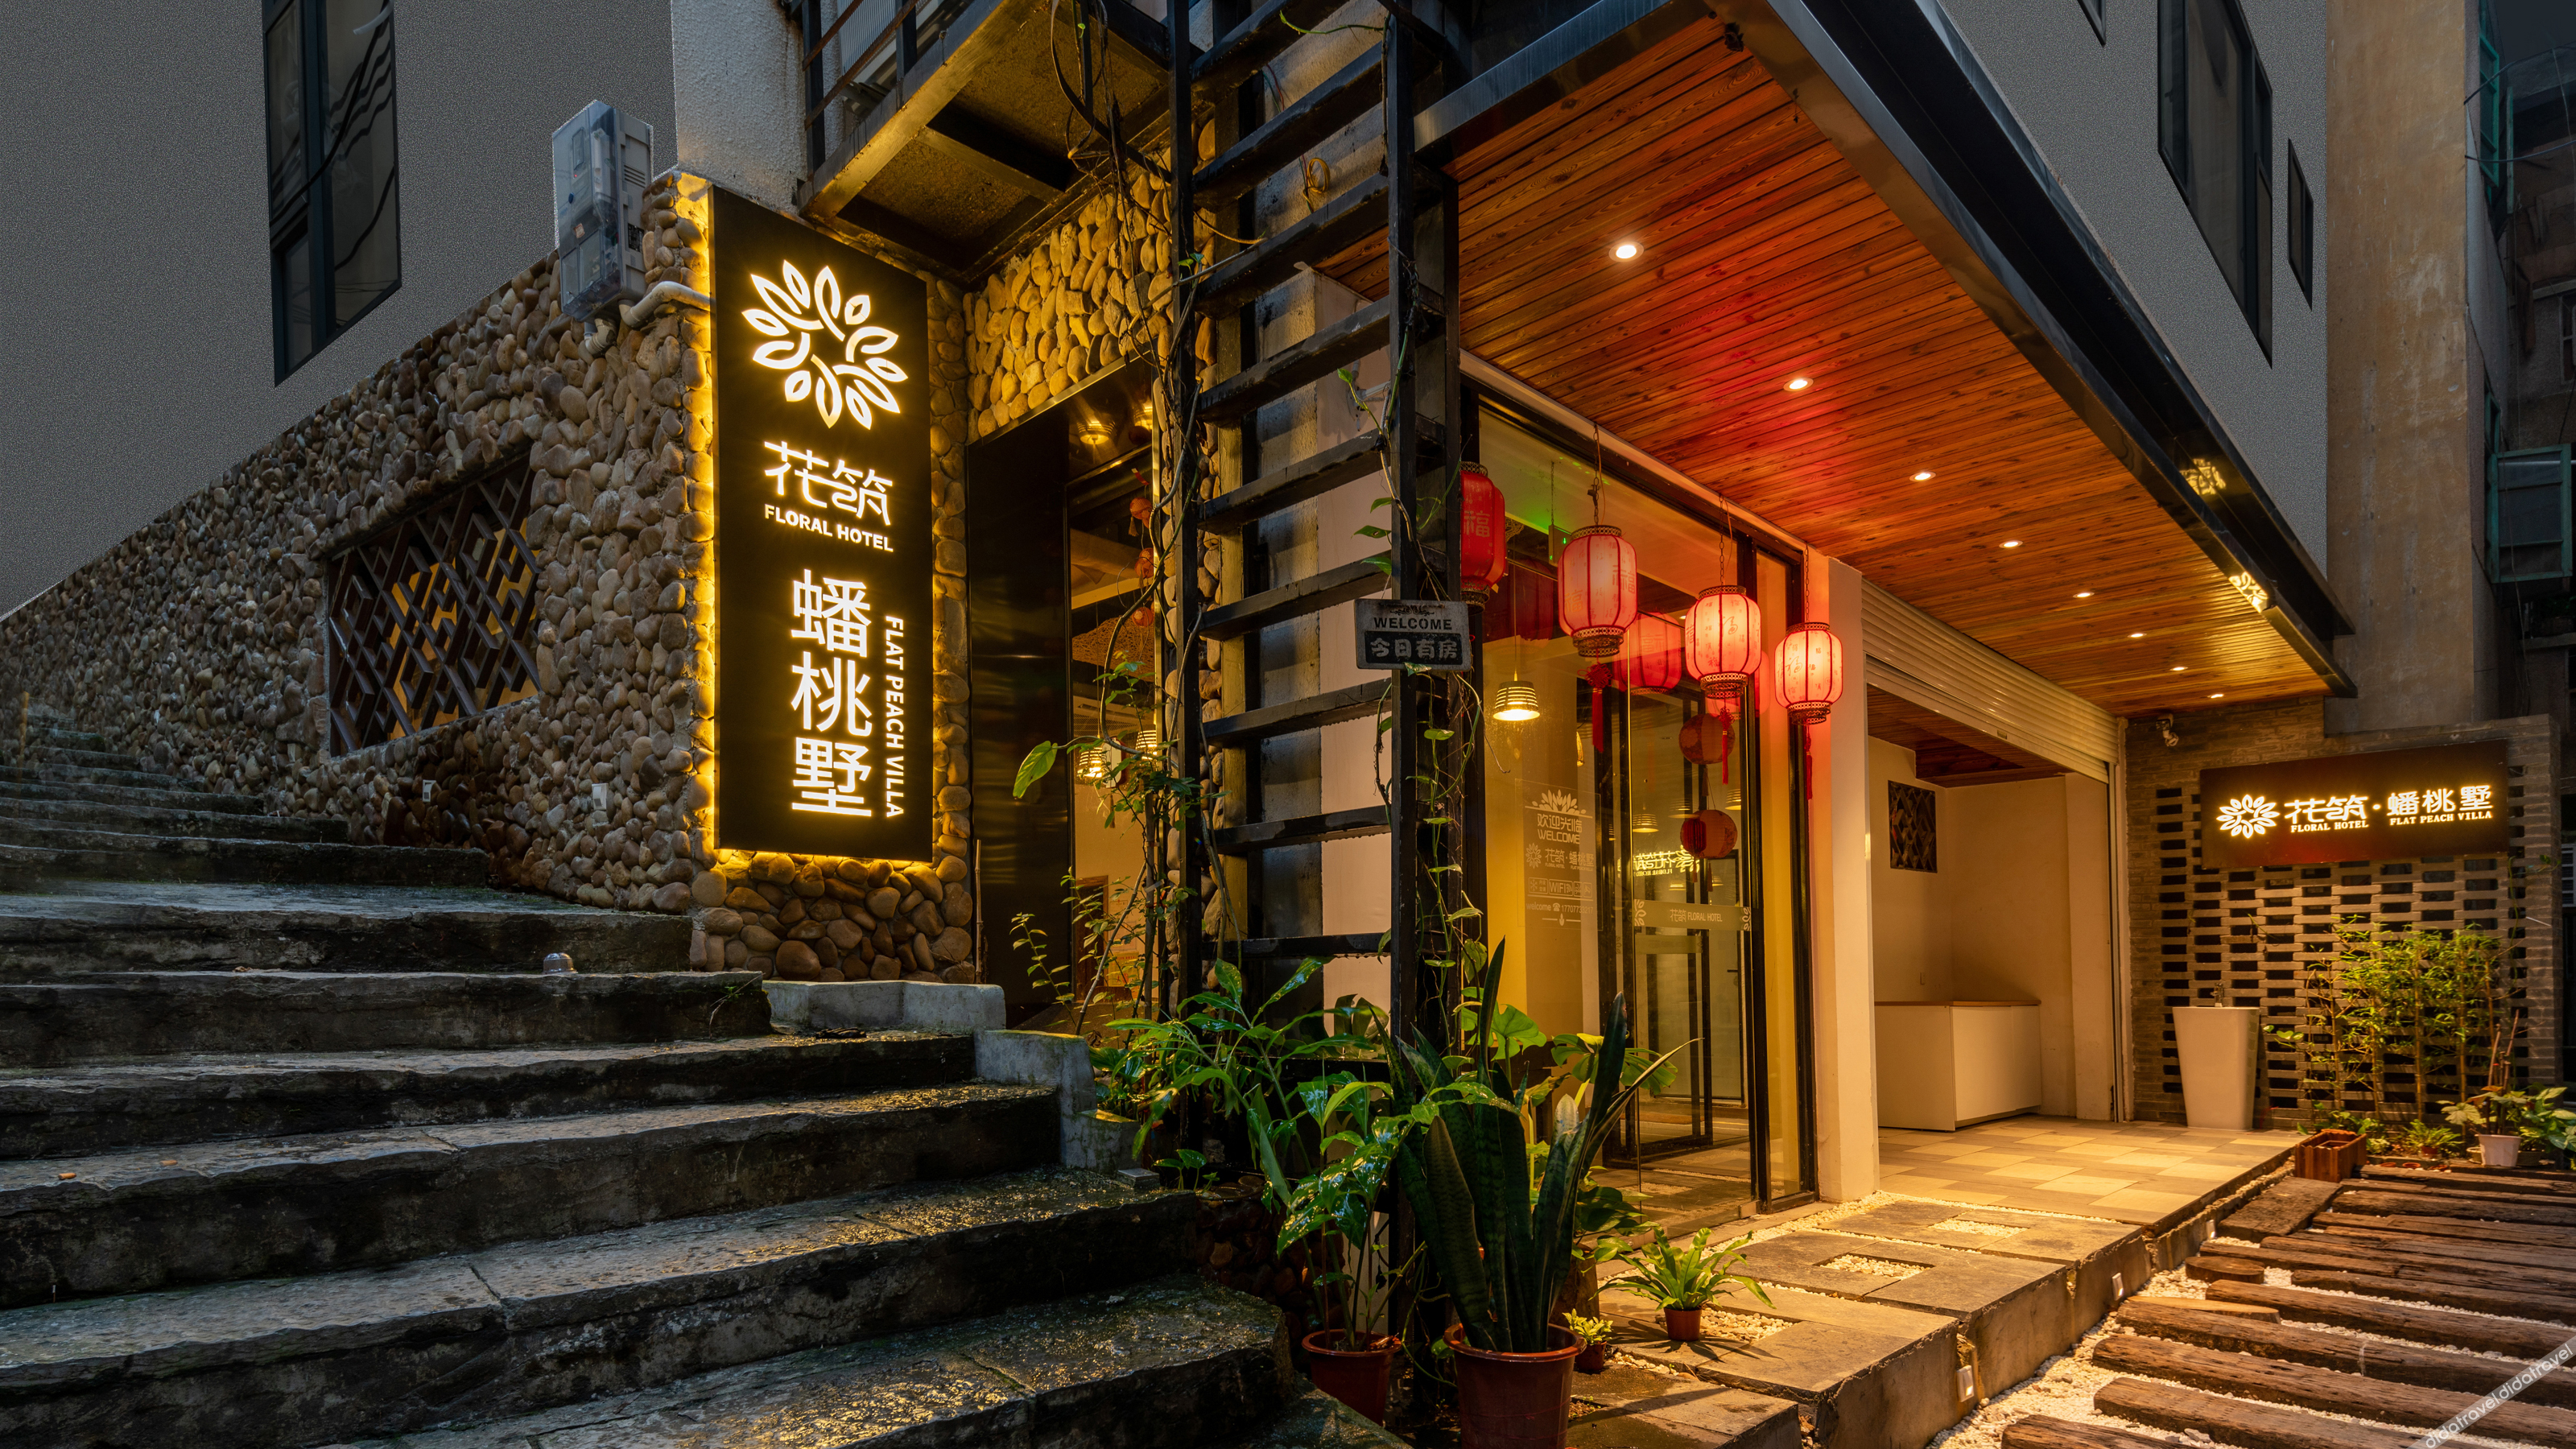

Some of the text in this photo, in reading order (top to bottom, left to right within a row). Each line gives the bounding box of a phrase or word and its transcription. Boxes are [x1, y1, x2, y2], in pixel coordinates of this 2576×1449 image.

[764, 441, 891, 526] 花筑
[765, 504, 894, 552] FLORAL HOTEL
[1374, 617, 1452, 630] WELCOME
[1370, 638, 1458, 659] 今日有房
[791, 569, 872, 817] 蟠桃墅
[886, 616, 904, 817] FLAT PEACH VILLA
[1538, 813, 1583, 833] 欢迎光临
[2291, 810, 2492, 832] FLORAL HOTEL FLAT PEACH VILLA
[1538, 828, 1580, 844] WELCOME
[1549, 881, 1567, 894] WIFI
[1526, 902, 1551, 911] welcome
[1670, 908, 1686, 923] 花筑
[1687, 911, 1723, 923] FLORAL HOTEL
